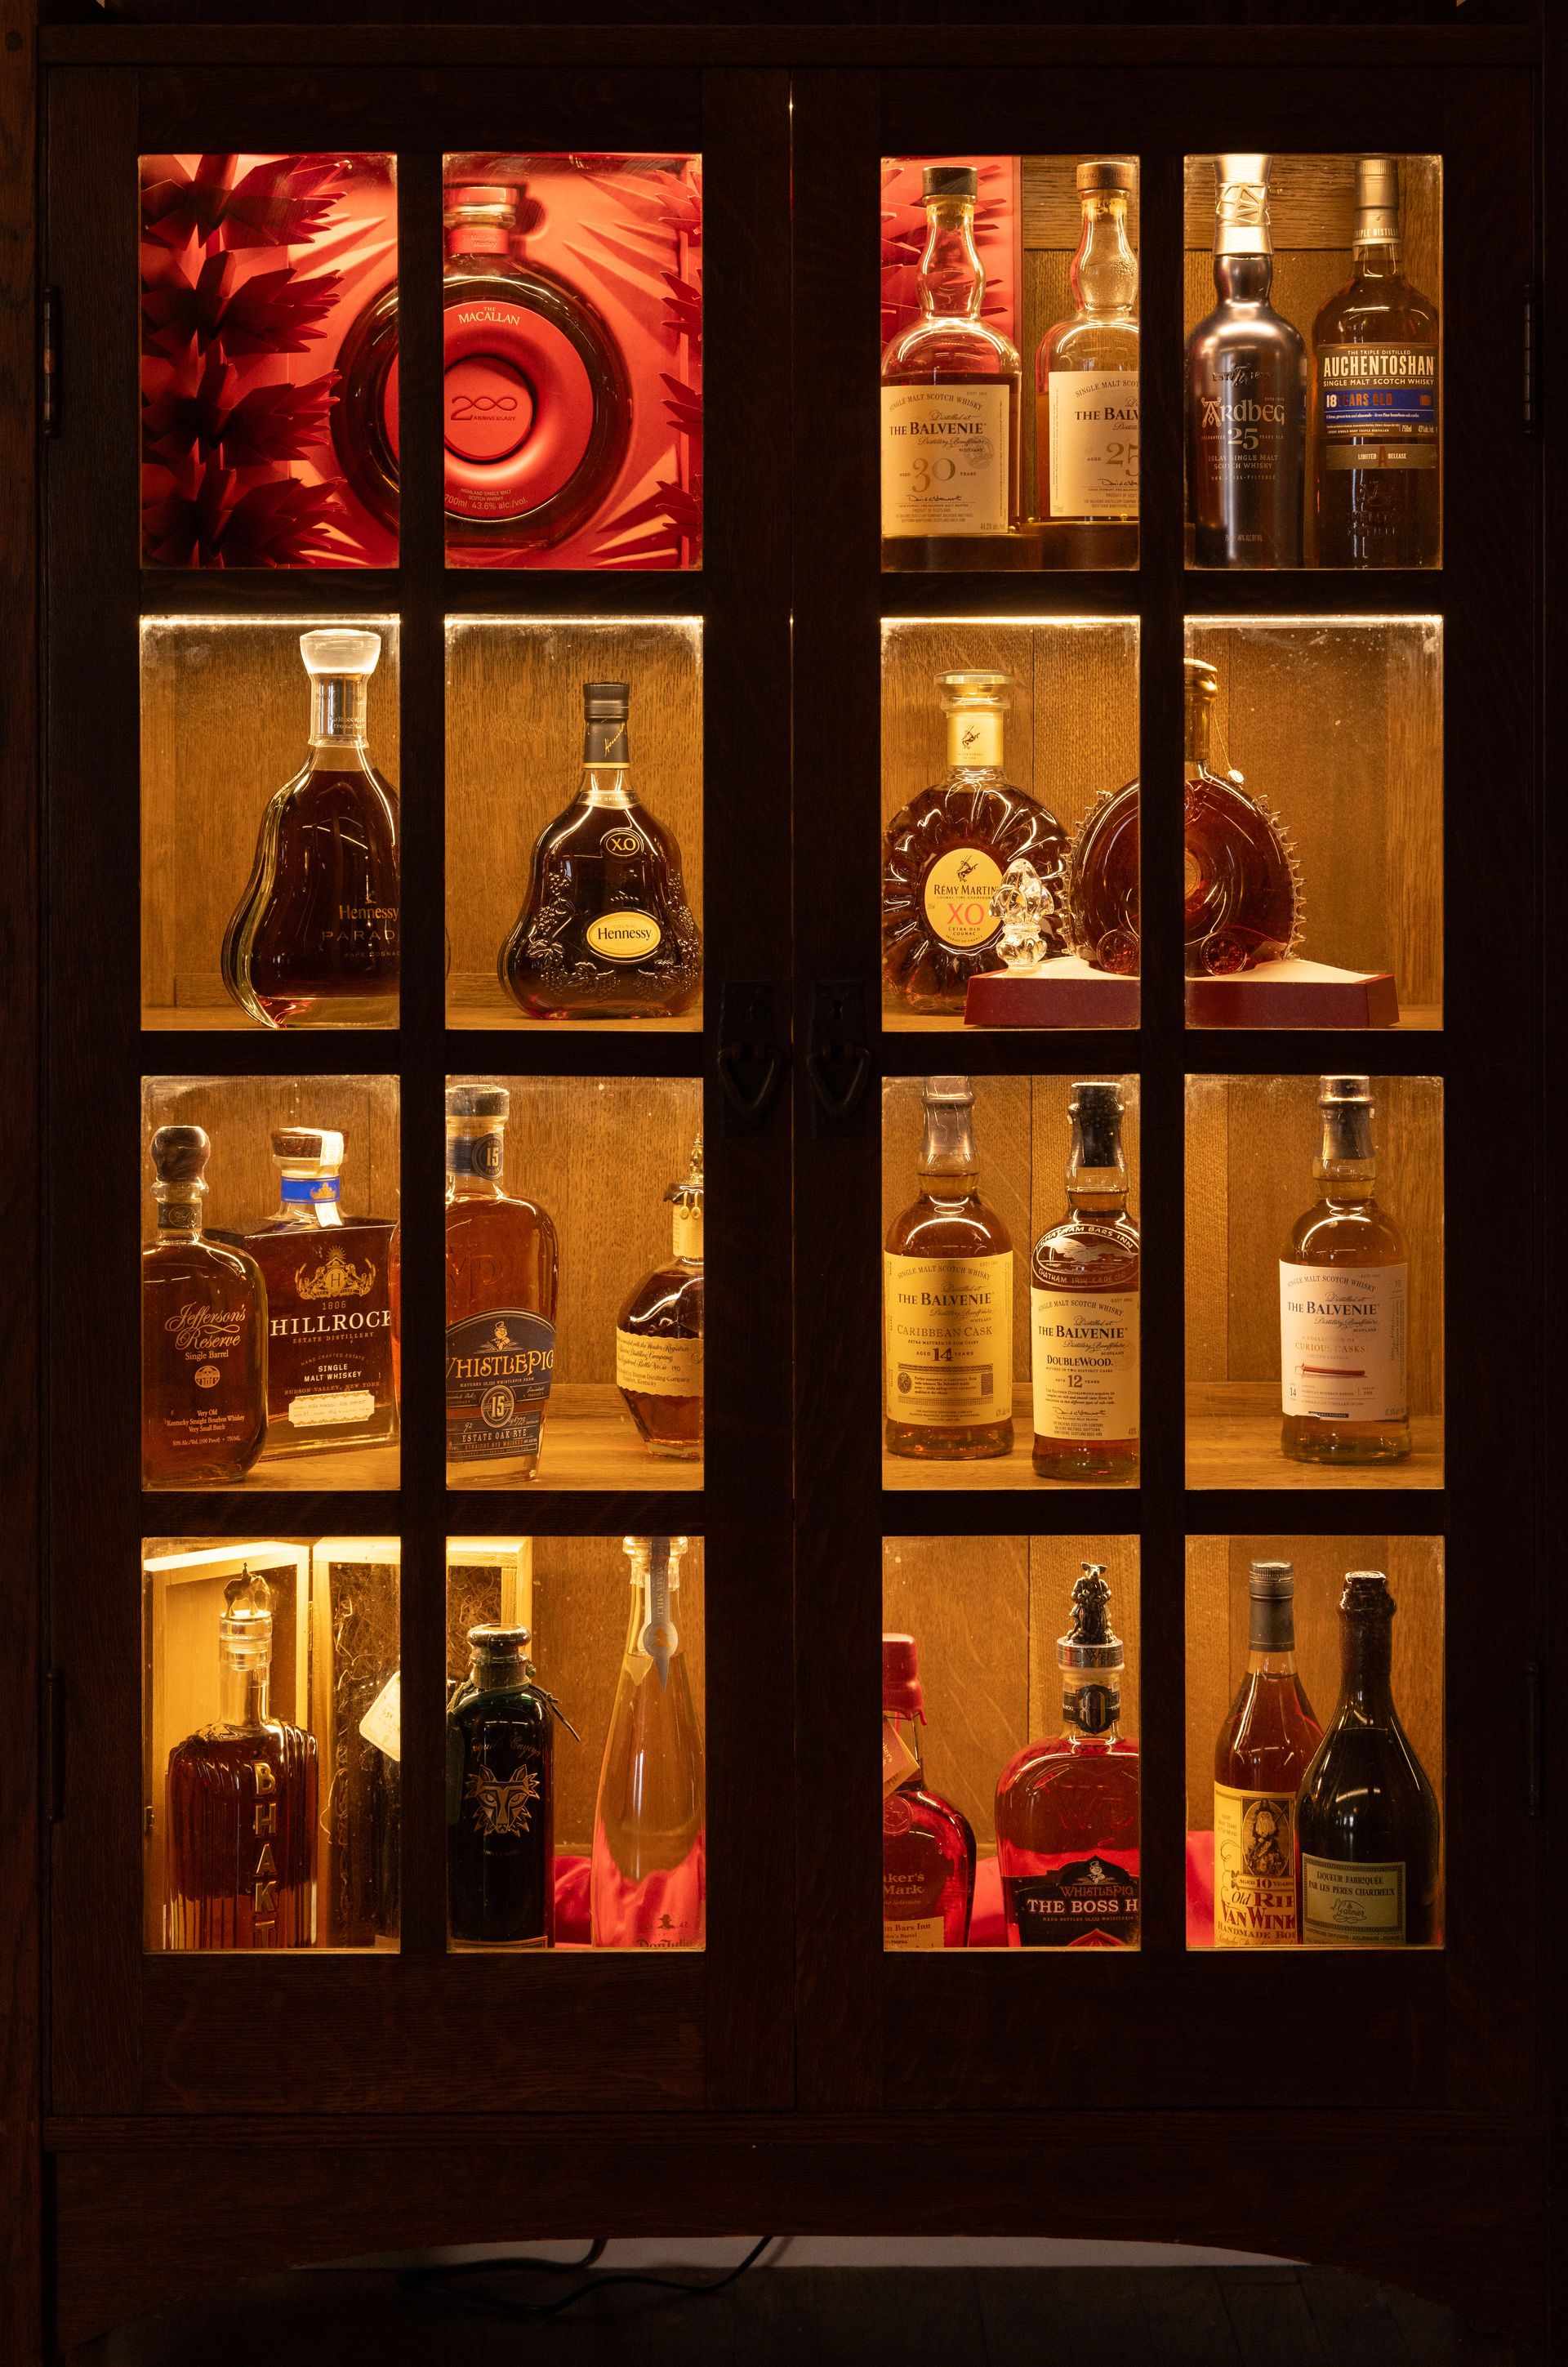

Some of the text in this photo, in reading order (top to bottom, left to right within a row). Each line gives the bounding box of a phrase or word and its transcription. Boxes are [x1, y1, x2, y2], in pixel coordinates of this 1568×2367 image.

[458, 311, 520, 326] MACALLAN
[1324, 355, 1434, 377] AUCHENTOSHAN
[1075, 381, 1120, 398] SINGLE MALT
[1324, 379, 1348, 387] SINGLE
[889, 397, 906, 412] SINGLE
[907, 394, 924, 403] MALT
[926, 393, 954, 402] SCOTCH
[956, 396, 983, 411] WHISKY
[1326, 391, 1392, 408] 18 YEARS OLD
[1075, 411, 1101, 421] THE
[889, 421, 983, 435] THE BALVENIE
[1227, 427, 1259, 450] 25
[1106, 442, 1138, 477] 25
[911, 457, 956, 493] 30
[471, 501, 497, 510] 43.6%
[933, 884, 996, 895] RÉMY MARTIN
[339, 904, 399, 921] Hennessy
[947, 903, 985, 925] XO
[598, 927, 652, 941] Hennessy
[487, 1147, 499, 1167] 15
[1088, 1226, 1113, 1237] BARS
[1116, 1234, 1134, 1249] INN
[898, 1268, 917, 1280] SINGLE
[968, 1267, 991, 1281] WHISKY
[1038, 1268, 1067, 1284] CHATHAM
[1287, 1277, 1303, 1289] SINGLE
[1322, 1275, 1348, 1284] SCOTCH
[1351, 1280, 1377, 1292] WHISKY
[322, 1301, 346, 1310] 1806
[898, 1292, 991, 1306] THE BALVENIE
[1071, 1299, 1097, 1309] SCOTCH
[1098, 1303, 1124, 1317] WHISKY
[1287, 1301, 1378, 1316] THE BALVENIE
[165, 1301, 246, 1332] Jefferson's
[270, 1310, 392, 1336] HILLROCK
[175, 1325, 241, 1350] Reserve
[292, 1331, 374, 1344] ESTATE DISTILLERY
[898, 1324, 993, 1338] CARIBBEAN CASK
[1038, 1324, 1125, 1339] THE BALVENIE
[933, 1347, 954, 1362] 14
[1295, 1342, 1332, 1353] CURIOUS
[185, 1349, 229, 1362] Single Barrel
[318, 1363, 348, 1372] SINGLE
[446, 1349, 554, 1381] HISTLEPIG
[304, 1371, 362, 1383] MALT WHISKEY
[1067, 1375, 1083, 1389] 12
[1290, 1387, 1297, 1397] 14
[492, 1395, 506, 1418] 15
[167, 1419, 189, 1427] Kentucky
[189, 1417, 207, 1425] Straight
[227, 1414, 245, 1422] Whiskey
[462, 1428, 528, 1443] ESTATE OAK RYE
[1256, 1879, 1272, 1889] 10
[1316, 1870, 1343, 1883] LIQUEUR
[1059, 1885, 1134, 1897] WHISTLEPIG
[1308, 1880, 1318, 1890] PAR
[1320, 1883, 1330, 1892] LES
[1027, 1898, 1065, 1913] THE
[1071, 1899, 1119, 1913] BOSS
[1232, 1891, 1251, 1906] Old
[1221, 1901, 1247, 1928] VAN
[895, 1923, 915, 1932] Bars
[1218, 1921, 1272, 1939] HANDMADE
